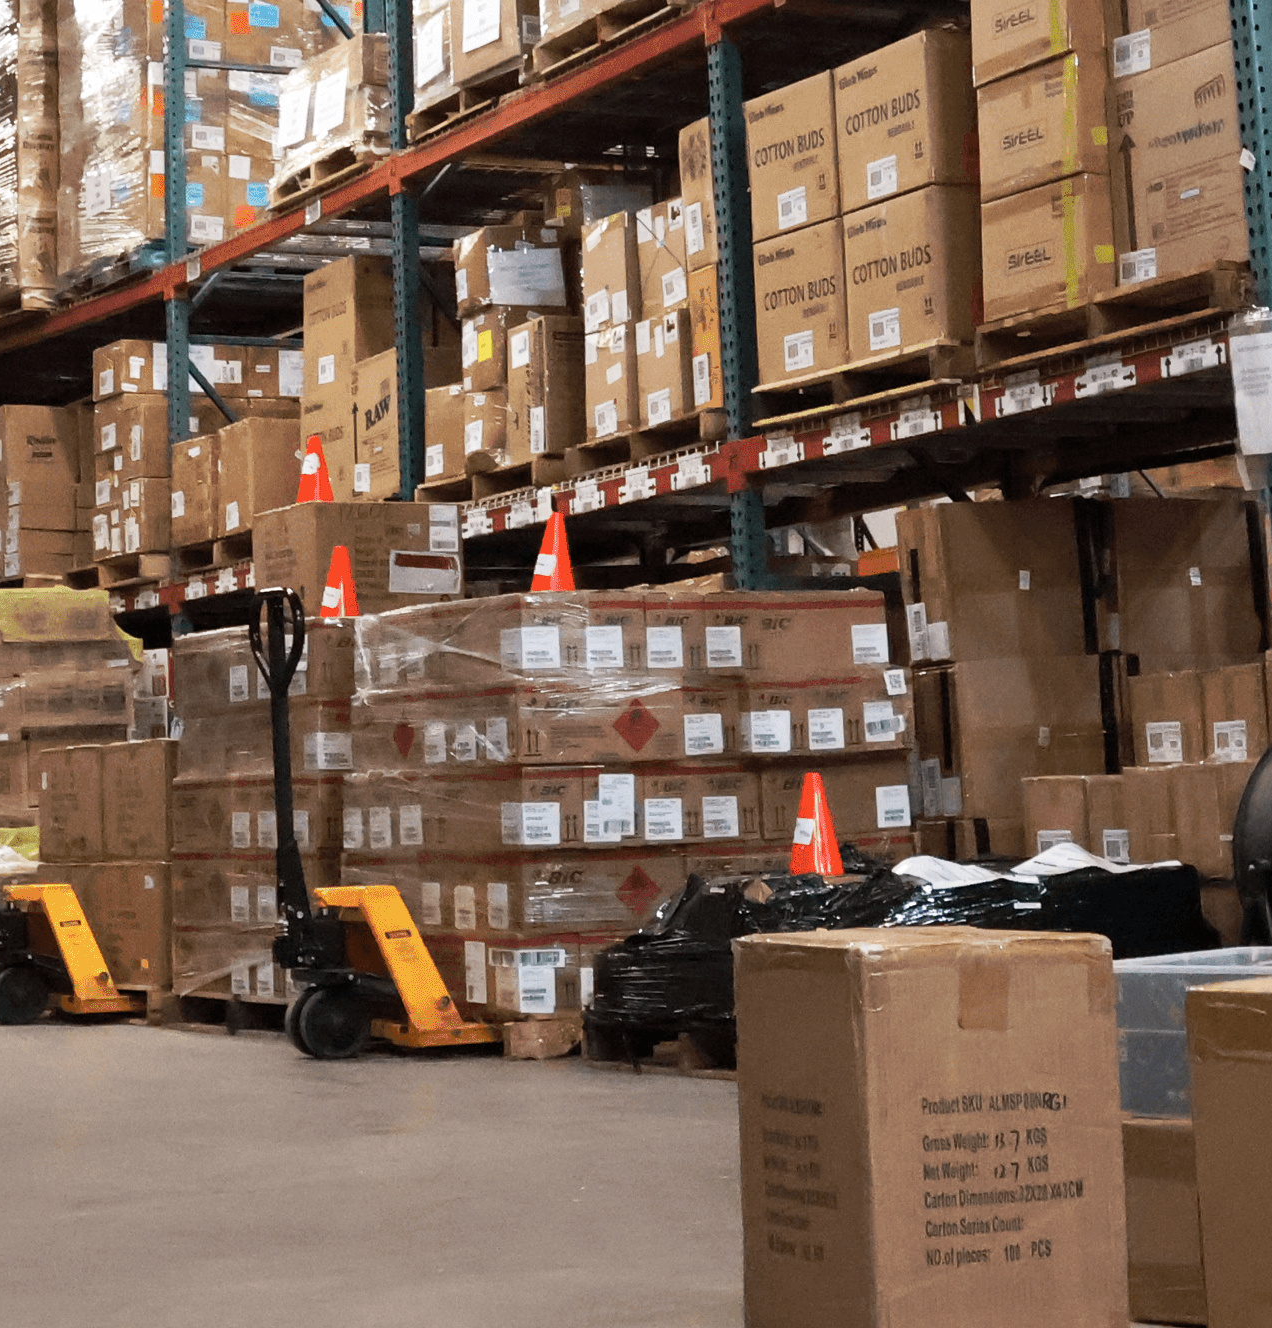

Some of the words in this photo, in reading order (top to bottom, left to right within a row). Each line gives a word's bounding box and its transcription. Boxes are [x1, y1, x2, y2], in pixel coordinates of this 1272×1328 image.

[846, 103, 888, 135] COTTON
[891, 89, 920, 118] BUDS
[755, 140, 795, 167] COTTON
[797, 128, 825, 153] BUDS
[853, 256, 897, 285] COTTON
[900, 244, 931, 271] BUDS
[764, 285, 805, 311] COTTON
[807, 275, 836, 300] BUDS
[364, 394, 391, 431] RAW
[548, 871, 584, 885] BIC
[922, 1097, 960, 1114] Product
[922, 1134, 951, 1152] Gross
[952, 1133, 989, 1153] Weight:
[1026, 1127, 1047, 1147] KGS
[923, 1163, 940, 1181] Net
[941, 1162, 978, 1182] Weight:
[1027, 1154, 1049, 1173] KGS
[924, 1191, 957, 1209] Carton
[925, 1220, 958, 1238] Carton
[992, 1216, 1024, 1233] Count:
[1031, 1239, 1052, 1258] PCS
